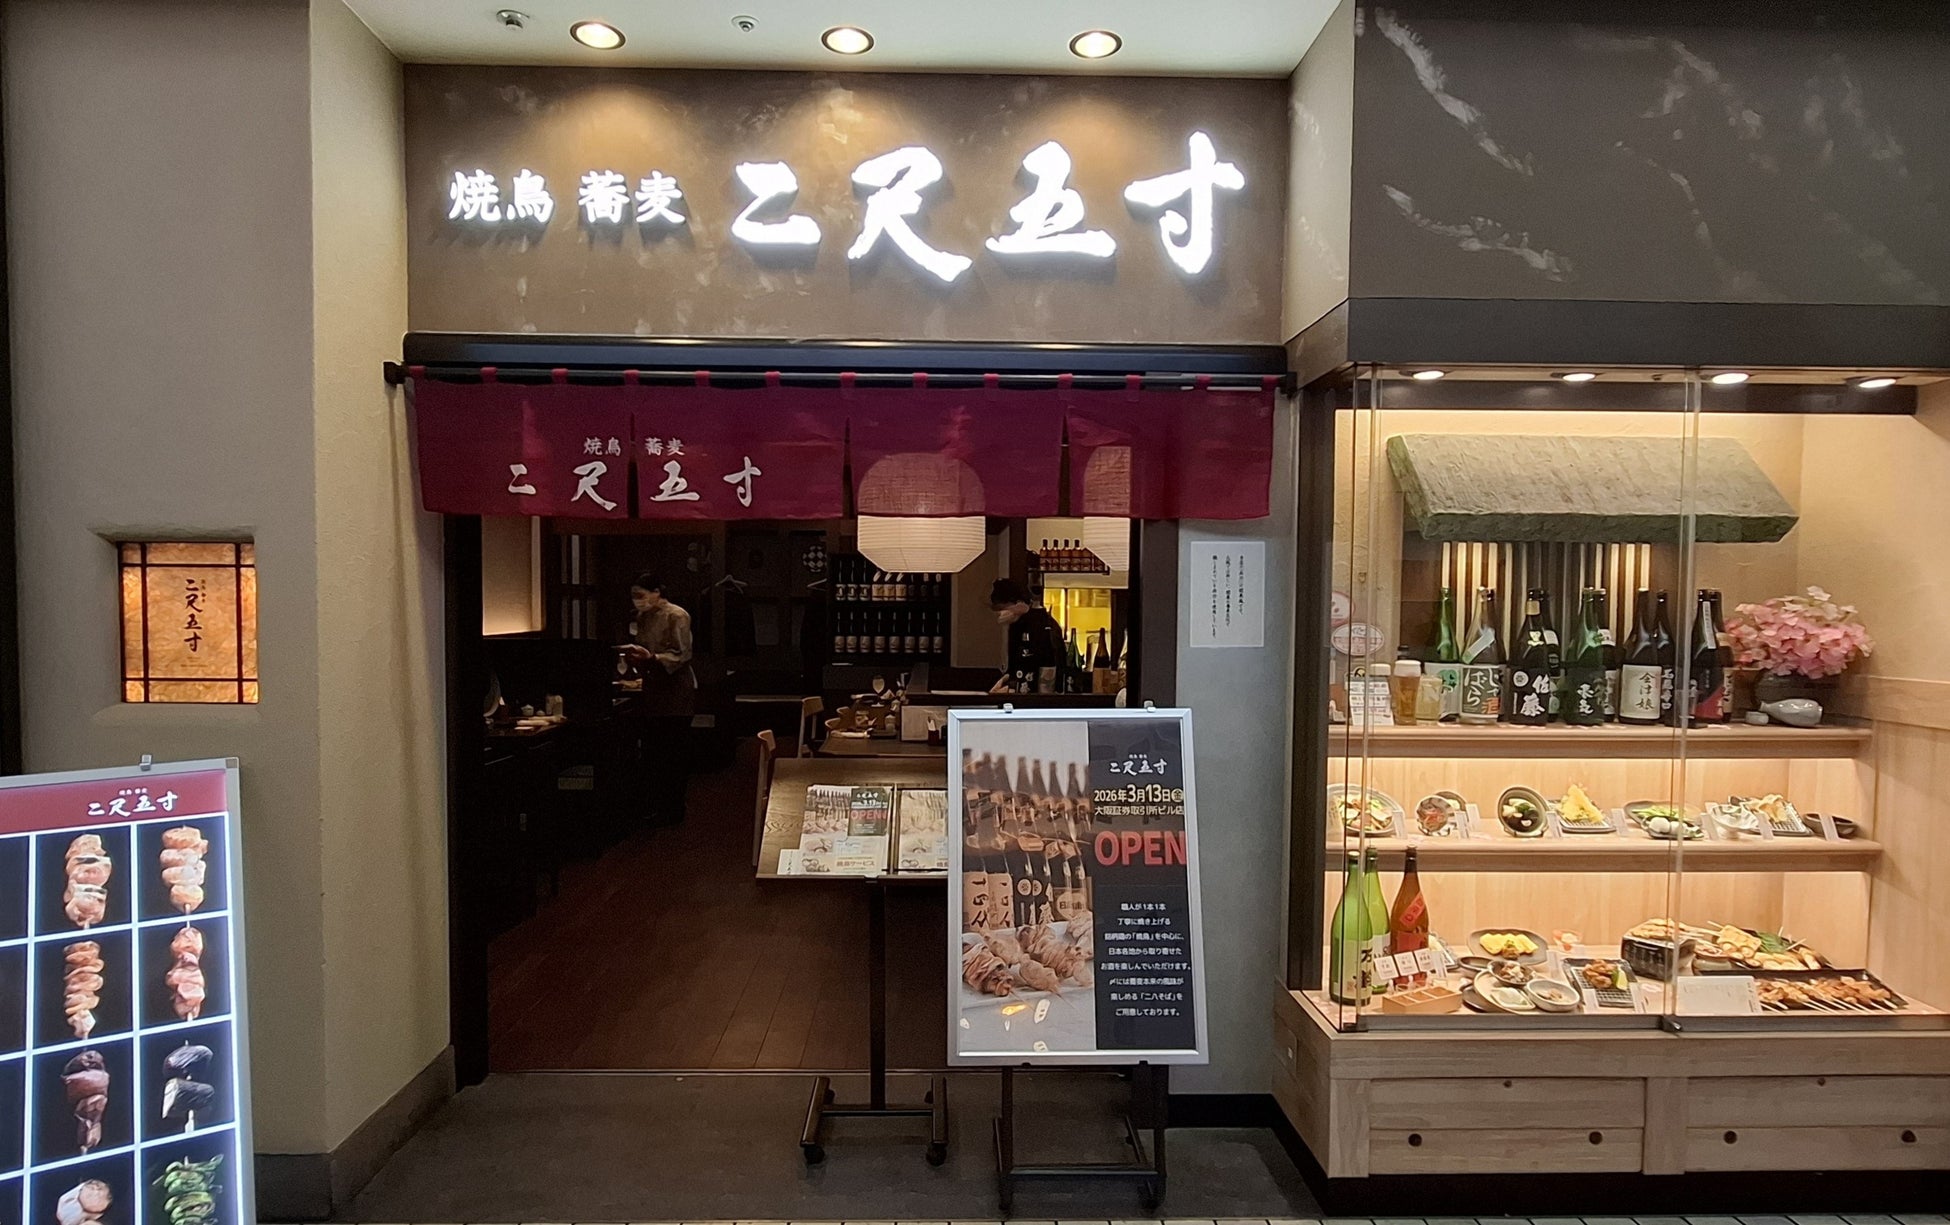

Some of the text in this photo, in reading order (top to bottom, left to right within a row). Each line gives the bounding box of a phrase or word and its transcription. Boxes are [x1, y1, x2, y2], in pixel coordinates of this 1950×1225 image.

[449, 131, 1246, 282] 焼鳥 蕎麦 二尺五寸
[583, 437, 685, 456] 焼鳥 蕎麦
[508, 456, 762, 512] 二尺五寸
[183, 578, 203, 652] 二尺五寸
[1109, 758, 1168, 776] 二尺五寸
[87, 790, 178, 817] 二尺五寸
[1094, 830, 1187, 866] OPEN
